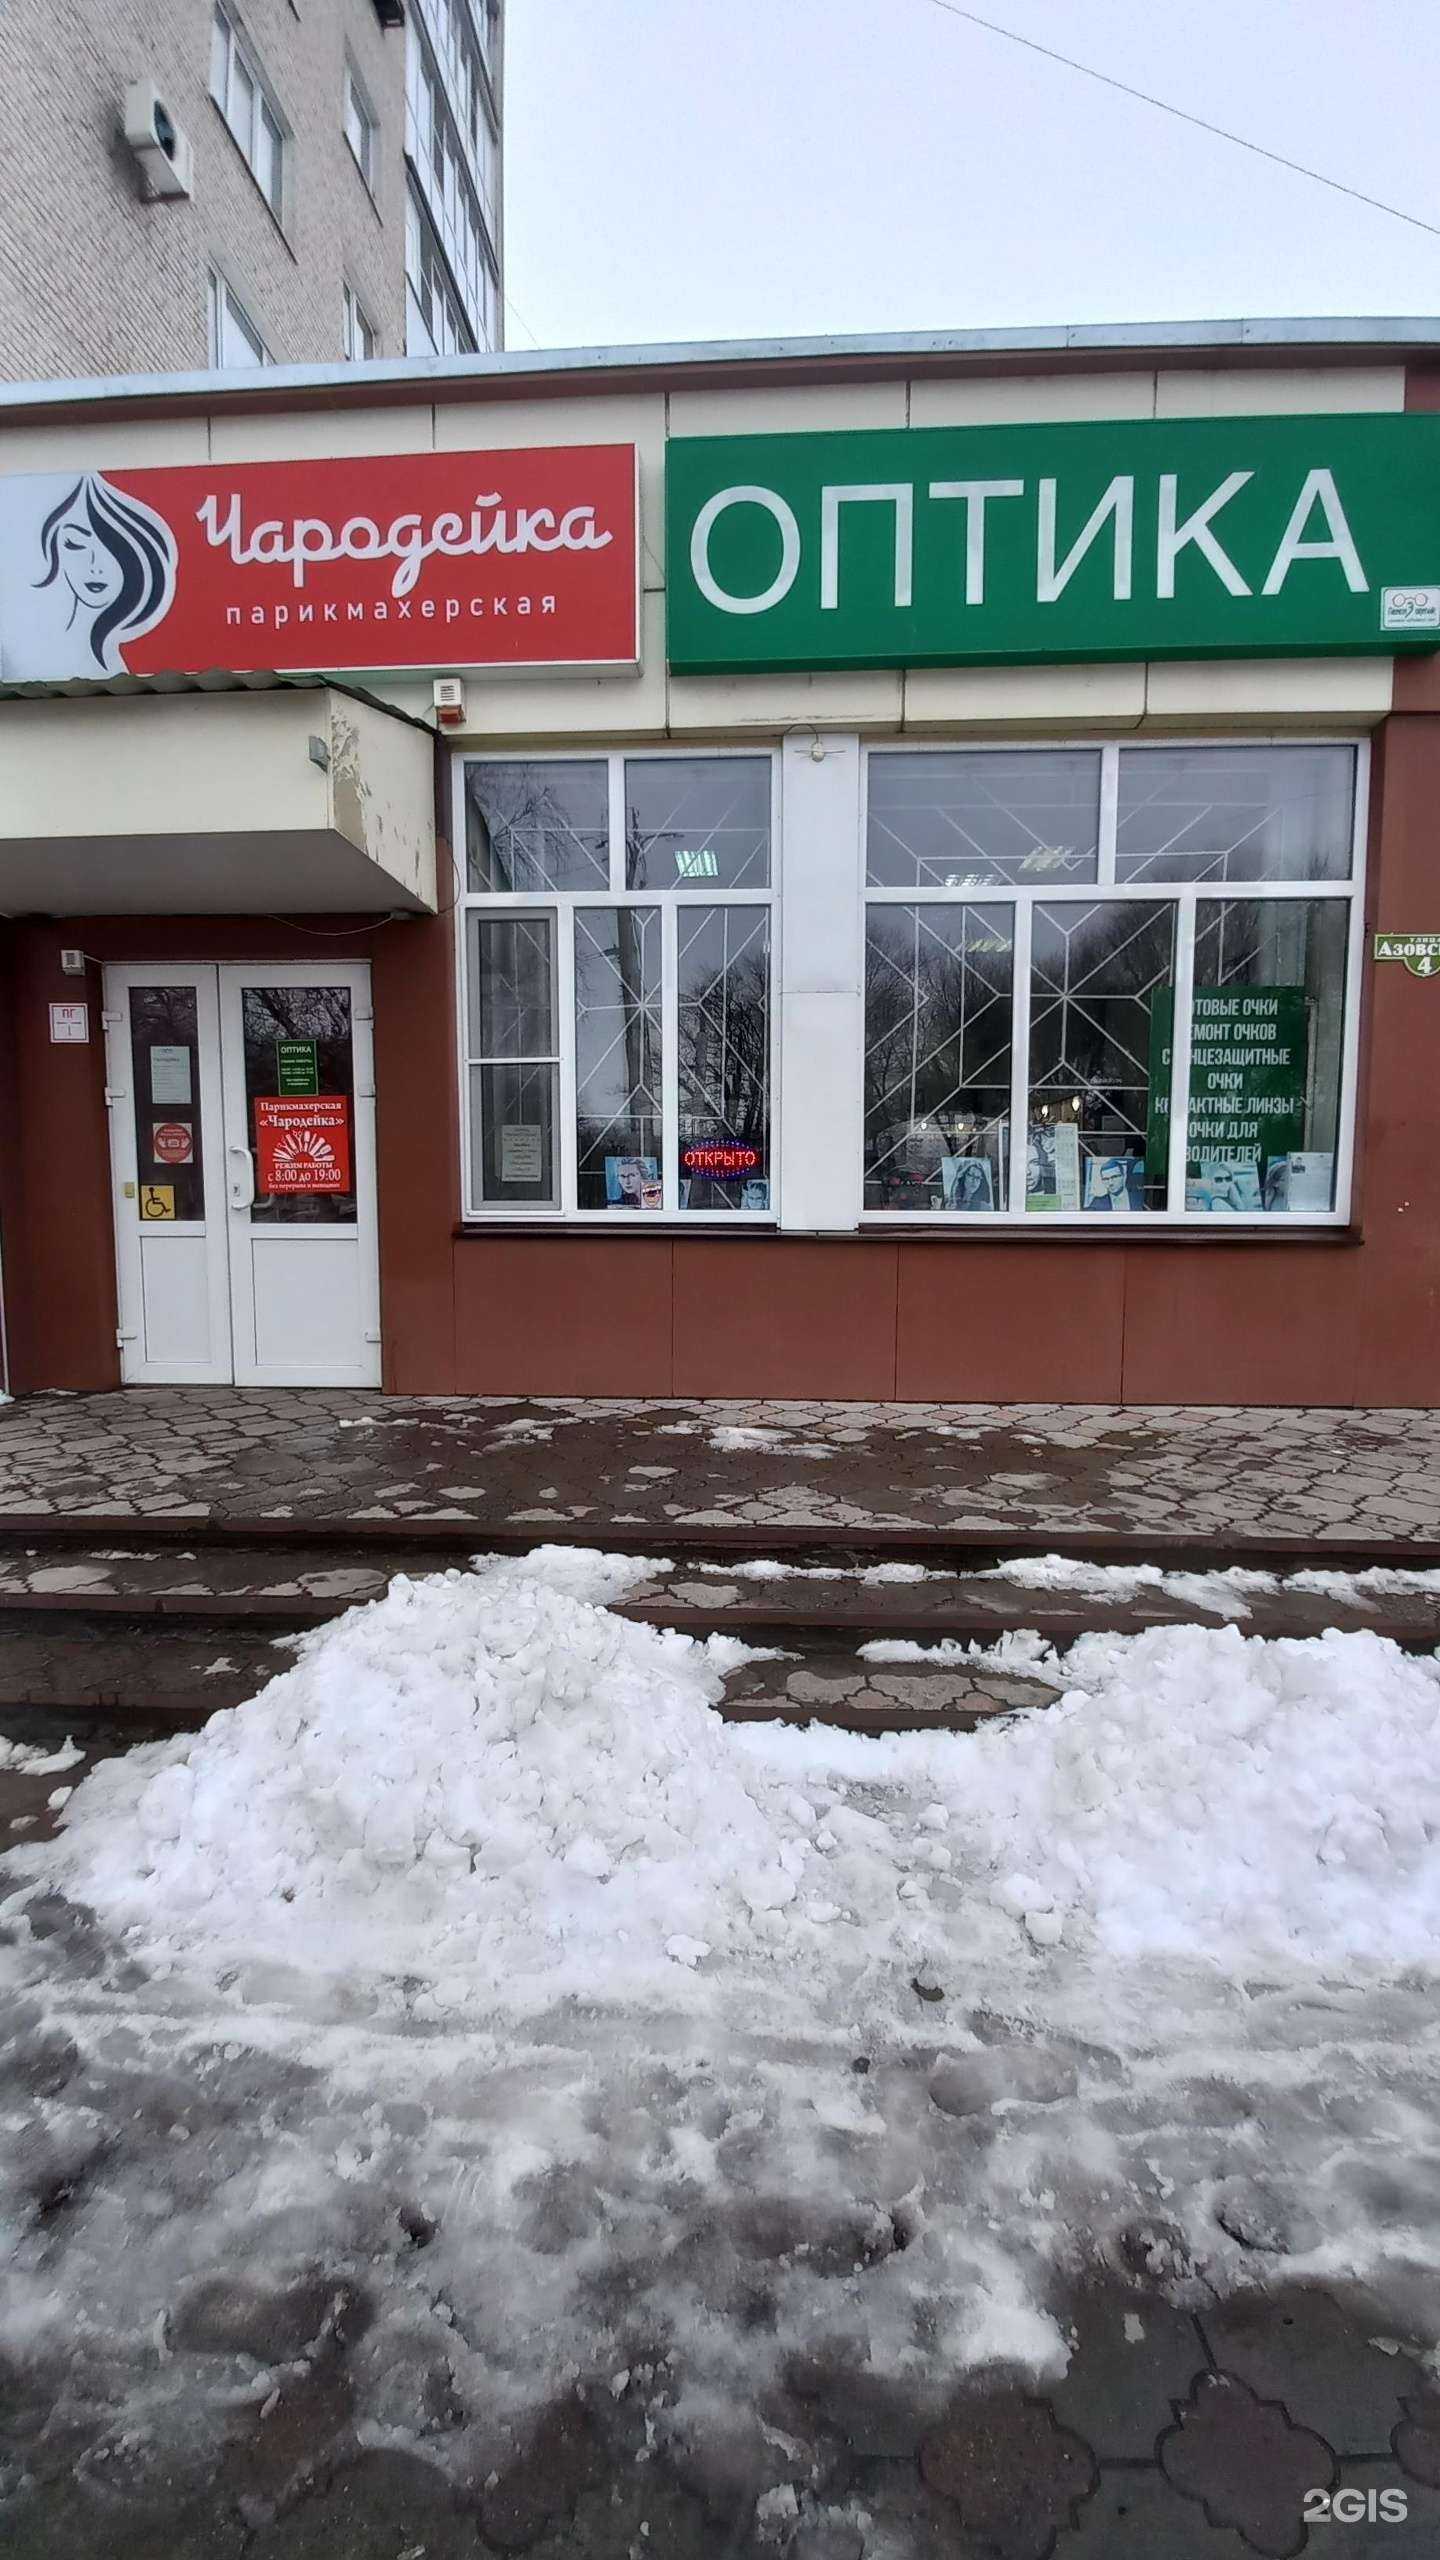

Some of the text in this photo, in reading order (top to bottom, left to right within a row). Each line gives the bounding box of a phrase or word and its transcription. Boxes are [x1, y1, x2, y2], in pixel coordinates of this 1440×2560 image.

[195, 491, 613, 598] Чародейка
[689, 467, 1370, 615] ОПТИКА
[225, 592, 558, 625] парикмахерская
[1378, 941, 1440, 956] АЗОВС
[1417, 956, 1433, 974] 4
[1242, 998, 1279, 1017] ОЧКИ
[1233, 1023, 1277, 1041] ОЧКОВ
[1161, 1047, 1291, 1066] СНЦЕЗАЩИТНЫЕ
[1207, 1072, 1244, 1090] ОЧКИ
[260, 1102, 342, 1113] Парикмахерская
[1244, 1096, 1295, 1114] ЛИНЗЫ
[1188, 1121, 1259, 1140] ОЧКИ ДЛЯ
[684, 1151, 756, 1166] ОТКРЫТО
[275, 1169, 297, 1182] 8:00
[313, 1168, 342, 1181] 19:00
